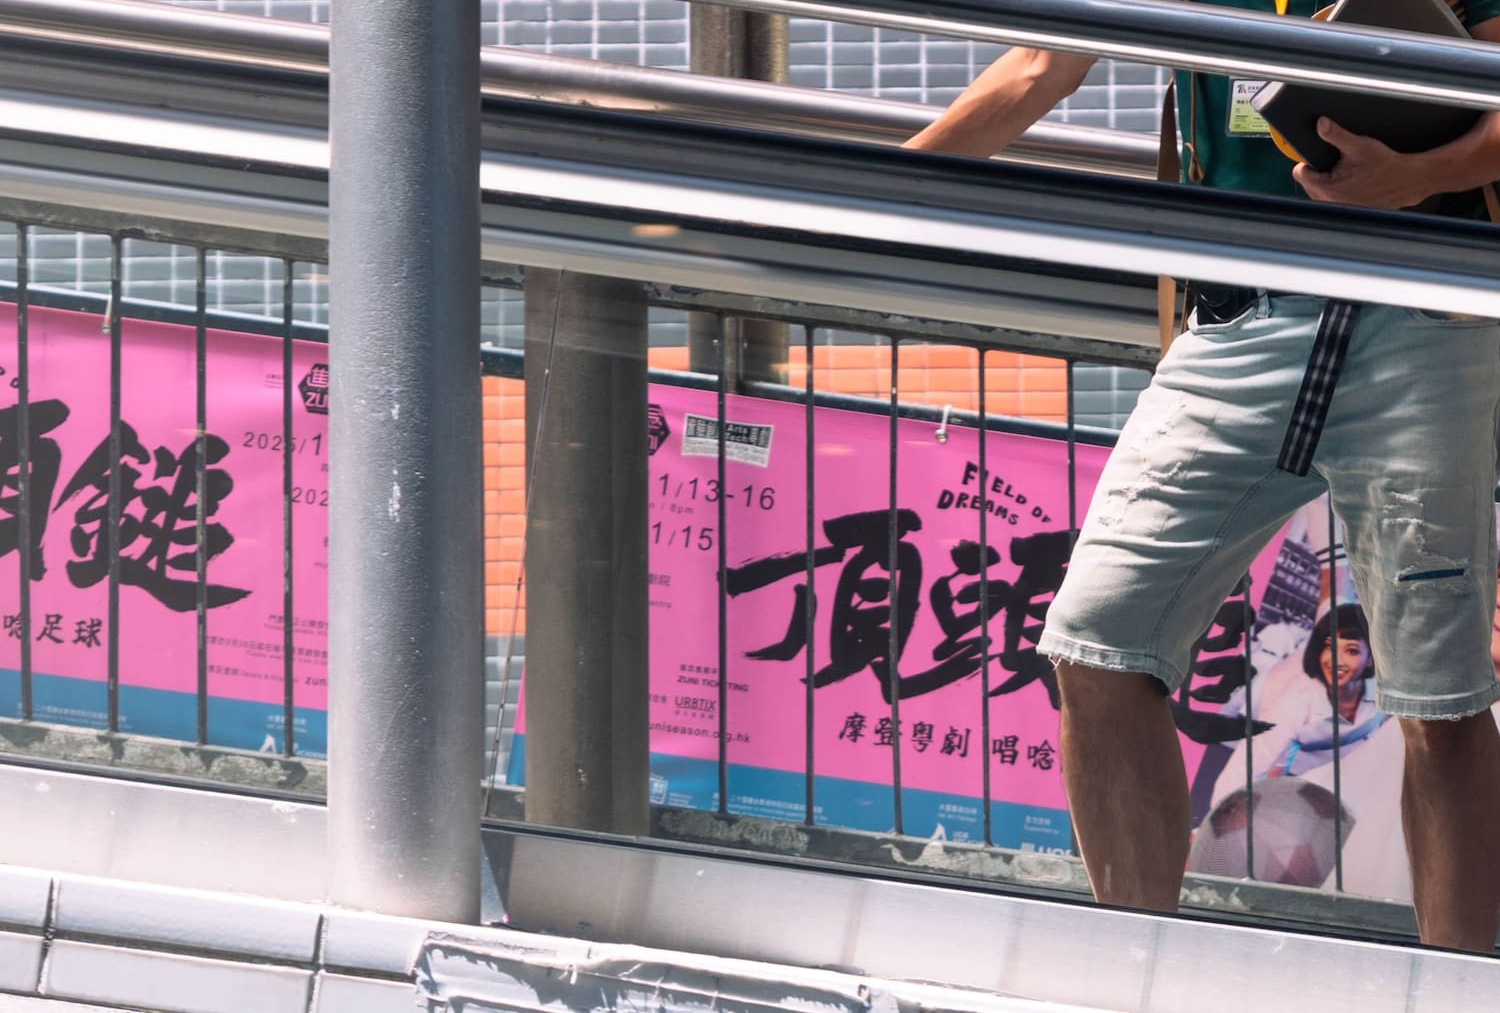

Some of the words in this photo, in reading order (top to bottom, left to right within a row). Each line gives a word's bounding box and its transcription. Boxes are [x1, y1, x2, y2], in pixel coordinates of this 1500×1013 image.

[962, 460, 1027, 505] FIELD
[937, 489, 1019, 526] DREAMS
[839, 711, 971, 758] 摩登粵劇
